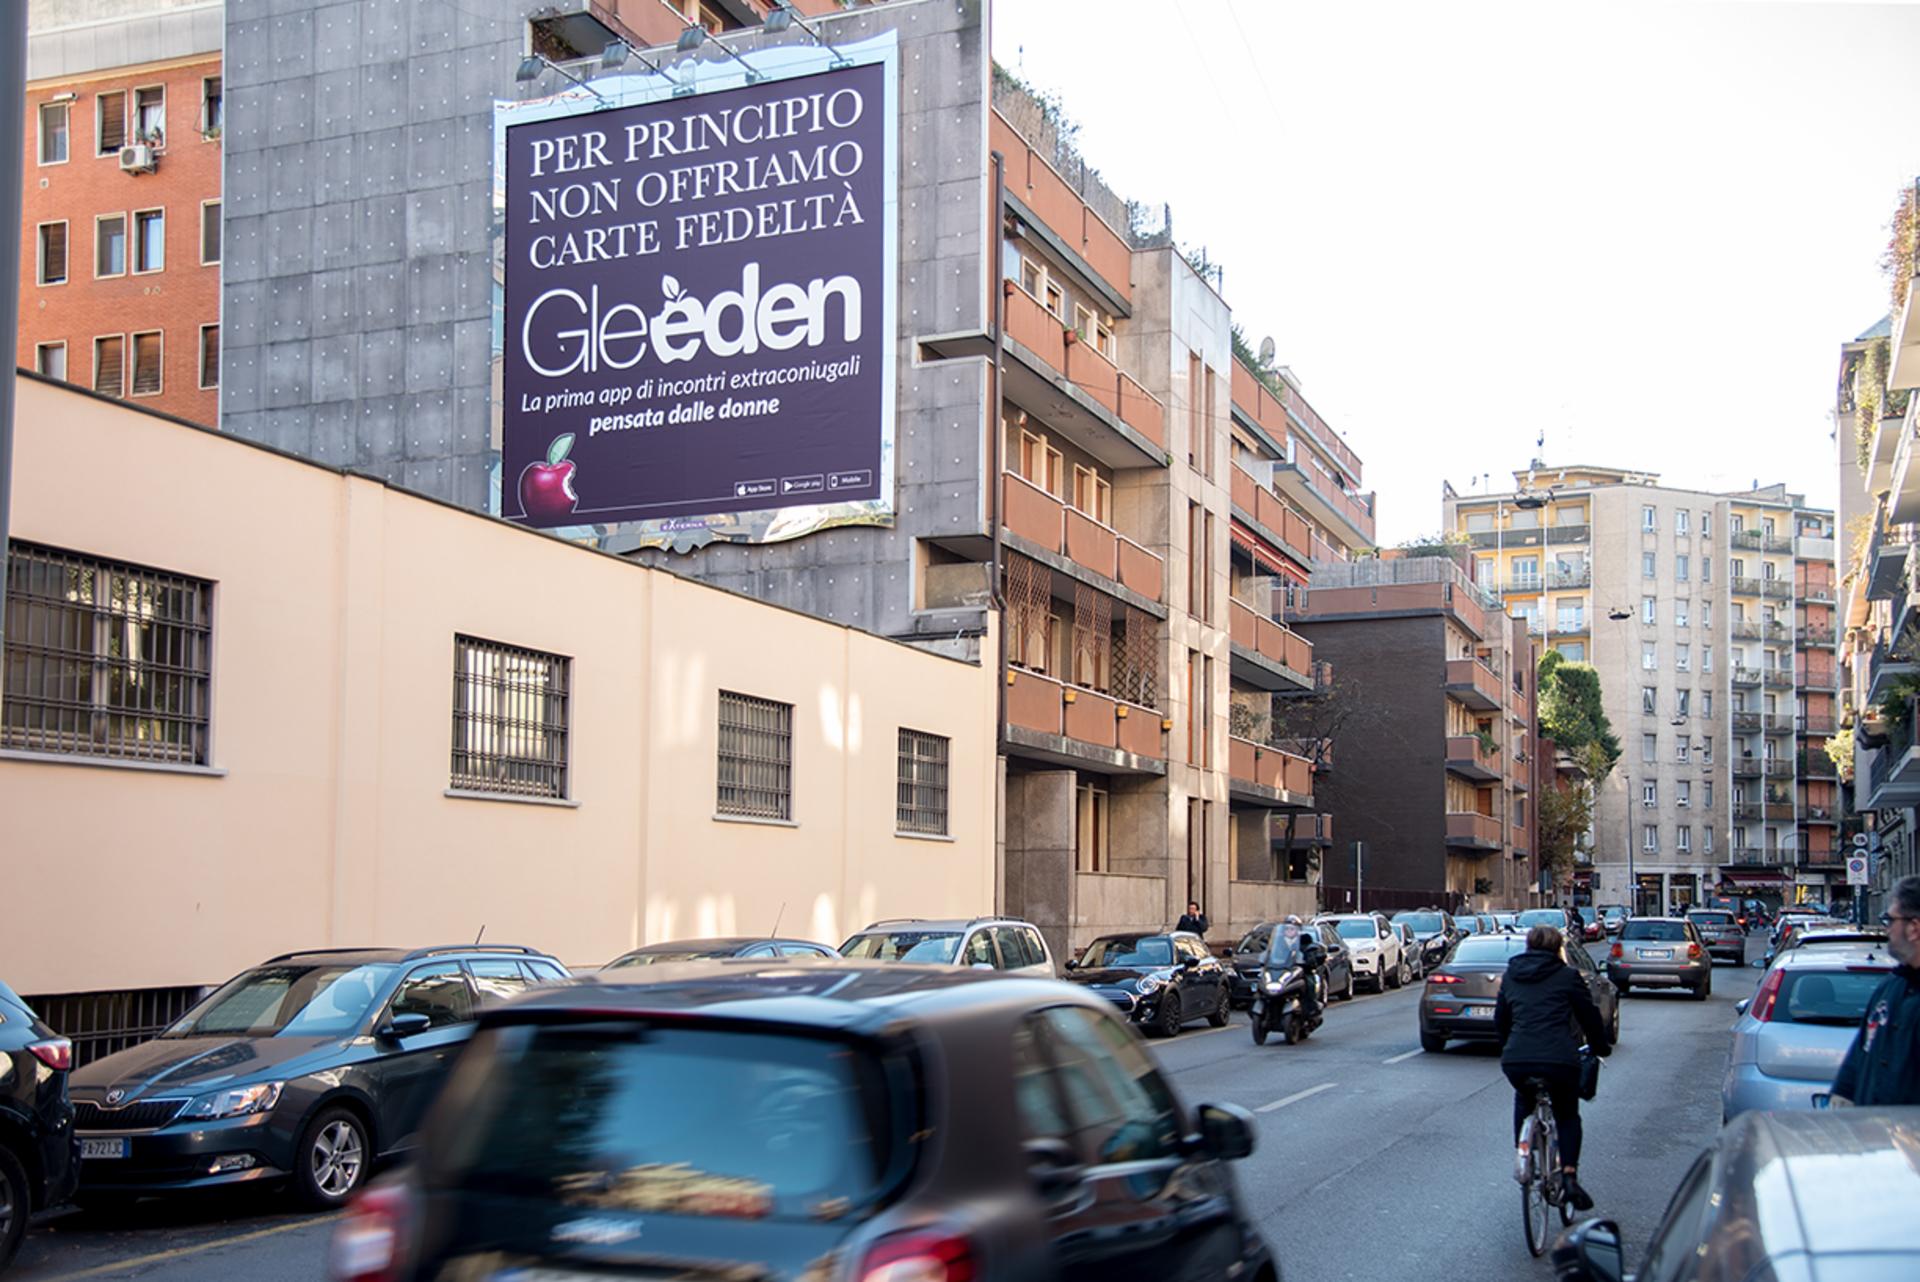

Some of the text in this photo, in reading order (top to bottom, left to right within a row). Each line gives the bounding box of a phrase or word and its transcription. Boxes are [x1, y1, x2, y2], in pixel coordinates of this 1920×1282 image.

[530, 88, 864, 178] PER PRINCIPIO
[529, 140, 864, 224] NON OFFRIAMO
[530, 182, 864, 269] CARTE FEDELTÀ
[521, 355, 862, 414] La prima app di incontri extraconiugali
[589, 395, 780, 436] pensata dalle donne
